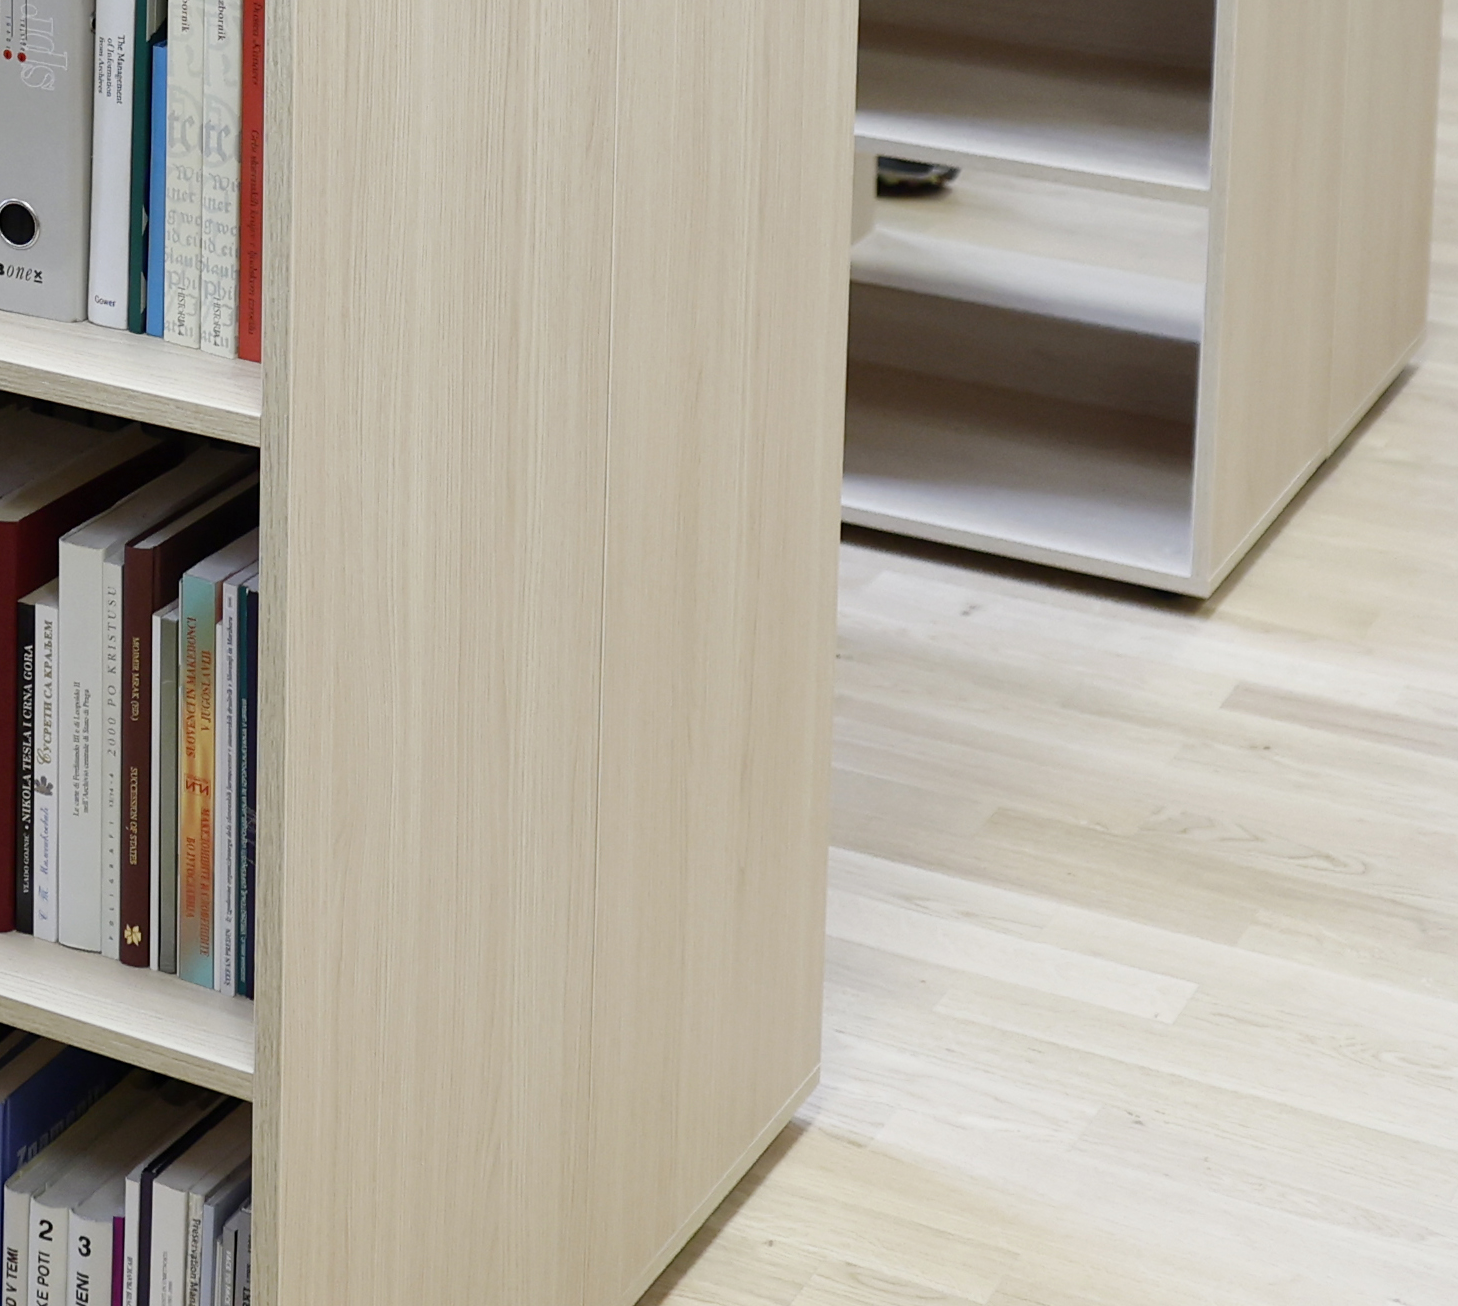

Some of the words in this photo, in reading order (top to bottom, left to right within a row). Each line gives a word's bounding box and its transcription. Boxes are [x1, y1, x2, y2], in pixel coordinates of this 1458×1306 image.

[107, 37, 114, 47] of
[106, 49, 114, 97] Information
[114, 52, 124, 104] Management
[108, 585, 116, 674] KRISTUSU
[108, 684, 116, 707] PO
[108, 716, 116, 757] 2000
[39, 1220, 53, 1241] 2
[78, 1235, 92, 1258] 3
[6, 1247, 18, 1278] TEMI
[38, 1251, 50, 1286] POTI
[7, 1283, 17, 1293] V
